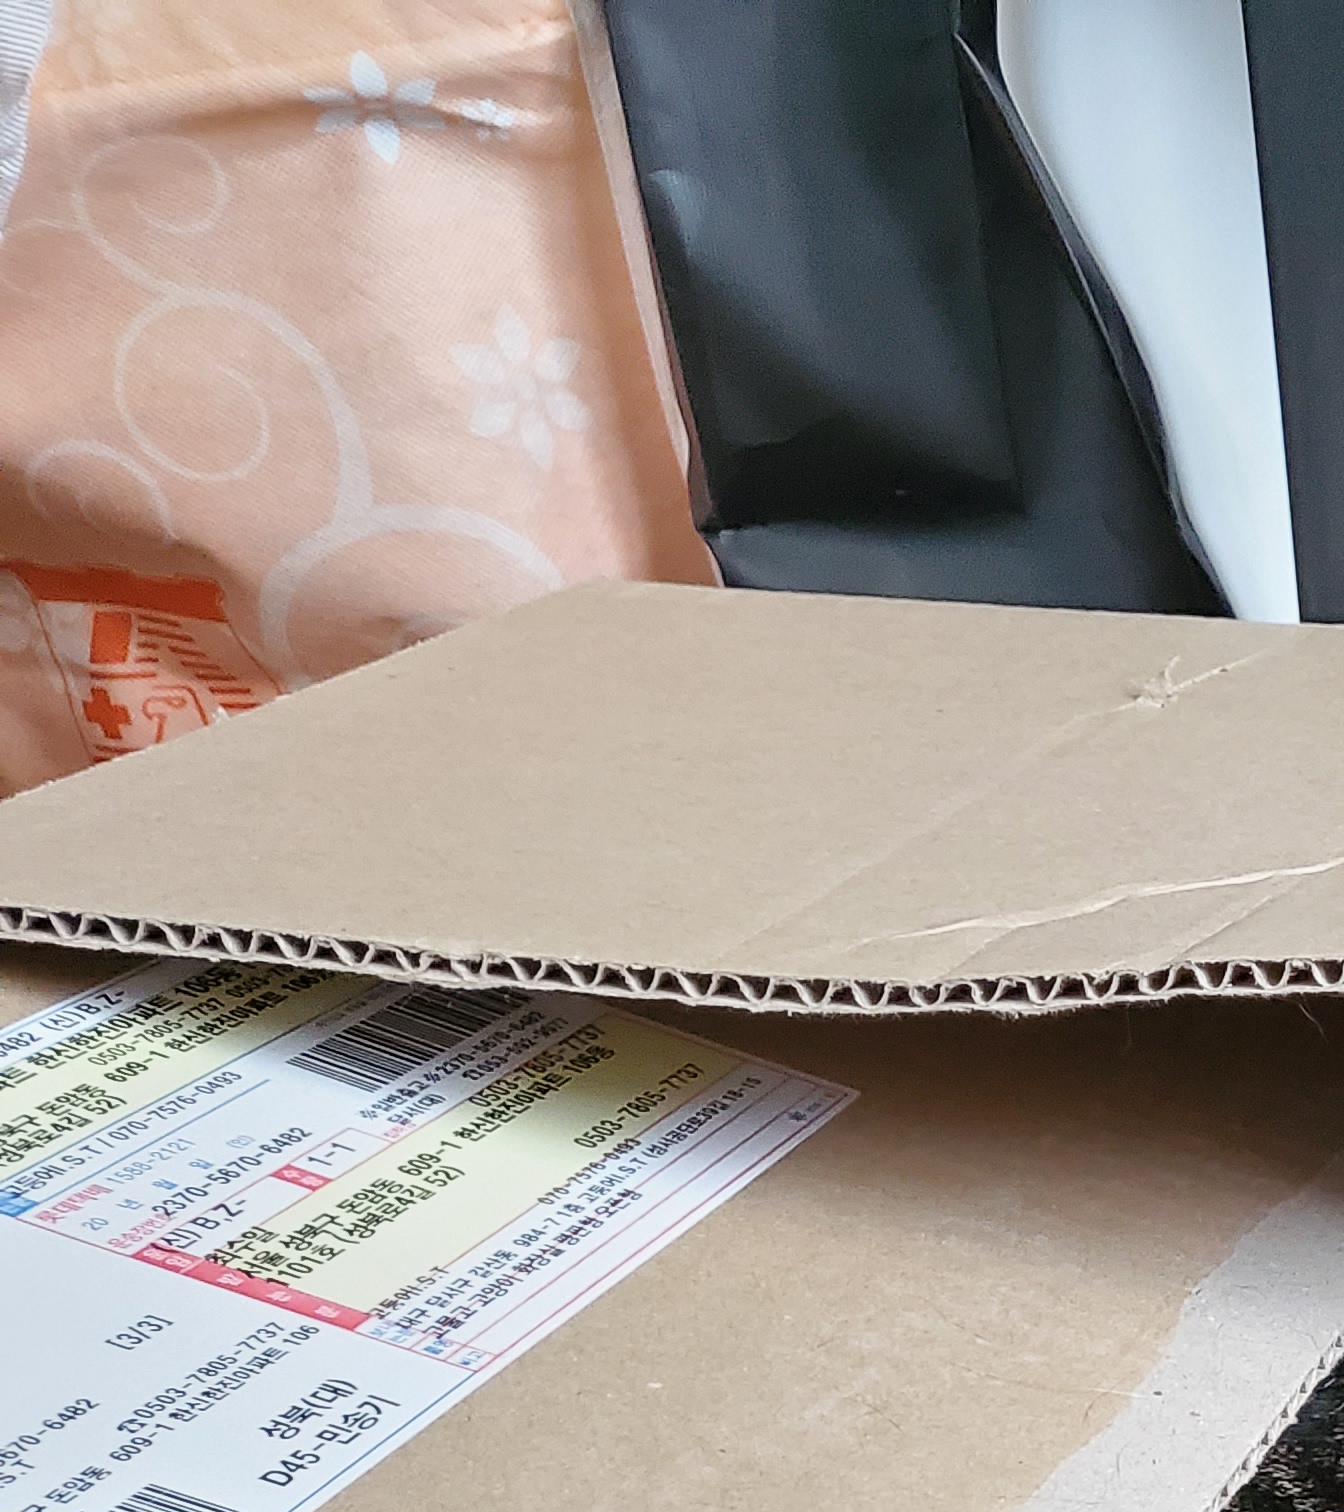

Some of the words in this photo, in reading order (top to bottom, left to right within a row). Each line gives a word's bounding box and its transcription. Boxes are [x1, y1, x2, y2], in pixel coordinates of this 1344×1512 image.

[108, 1071, 242, 1141] 070-7576-0493
[152, 1127, 313, 1218] 2370-5670-6482
[45, 1465, 112, 1506] 돈암동
[109, 1423, 176, 1463] 609-1
[283, 1324, 321, 1348] 106
[258, 1394, 401, 1488] D45-민송기
[259, 1378, 360, 1440] 성북(대)
